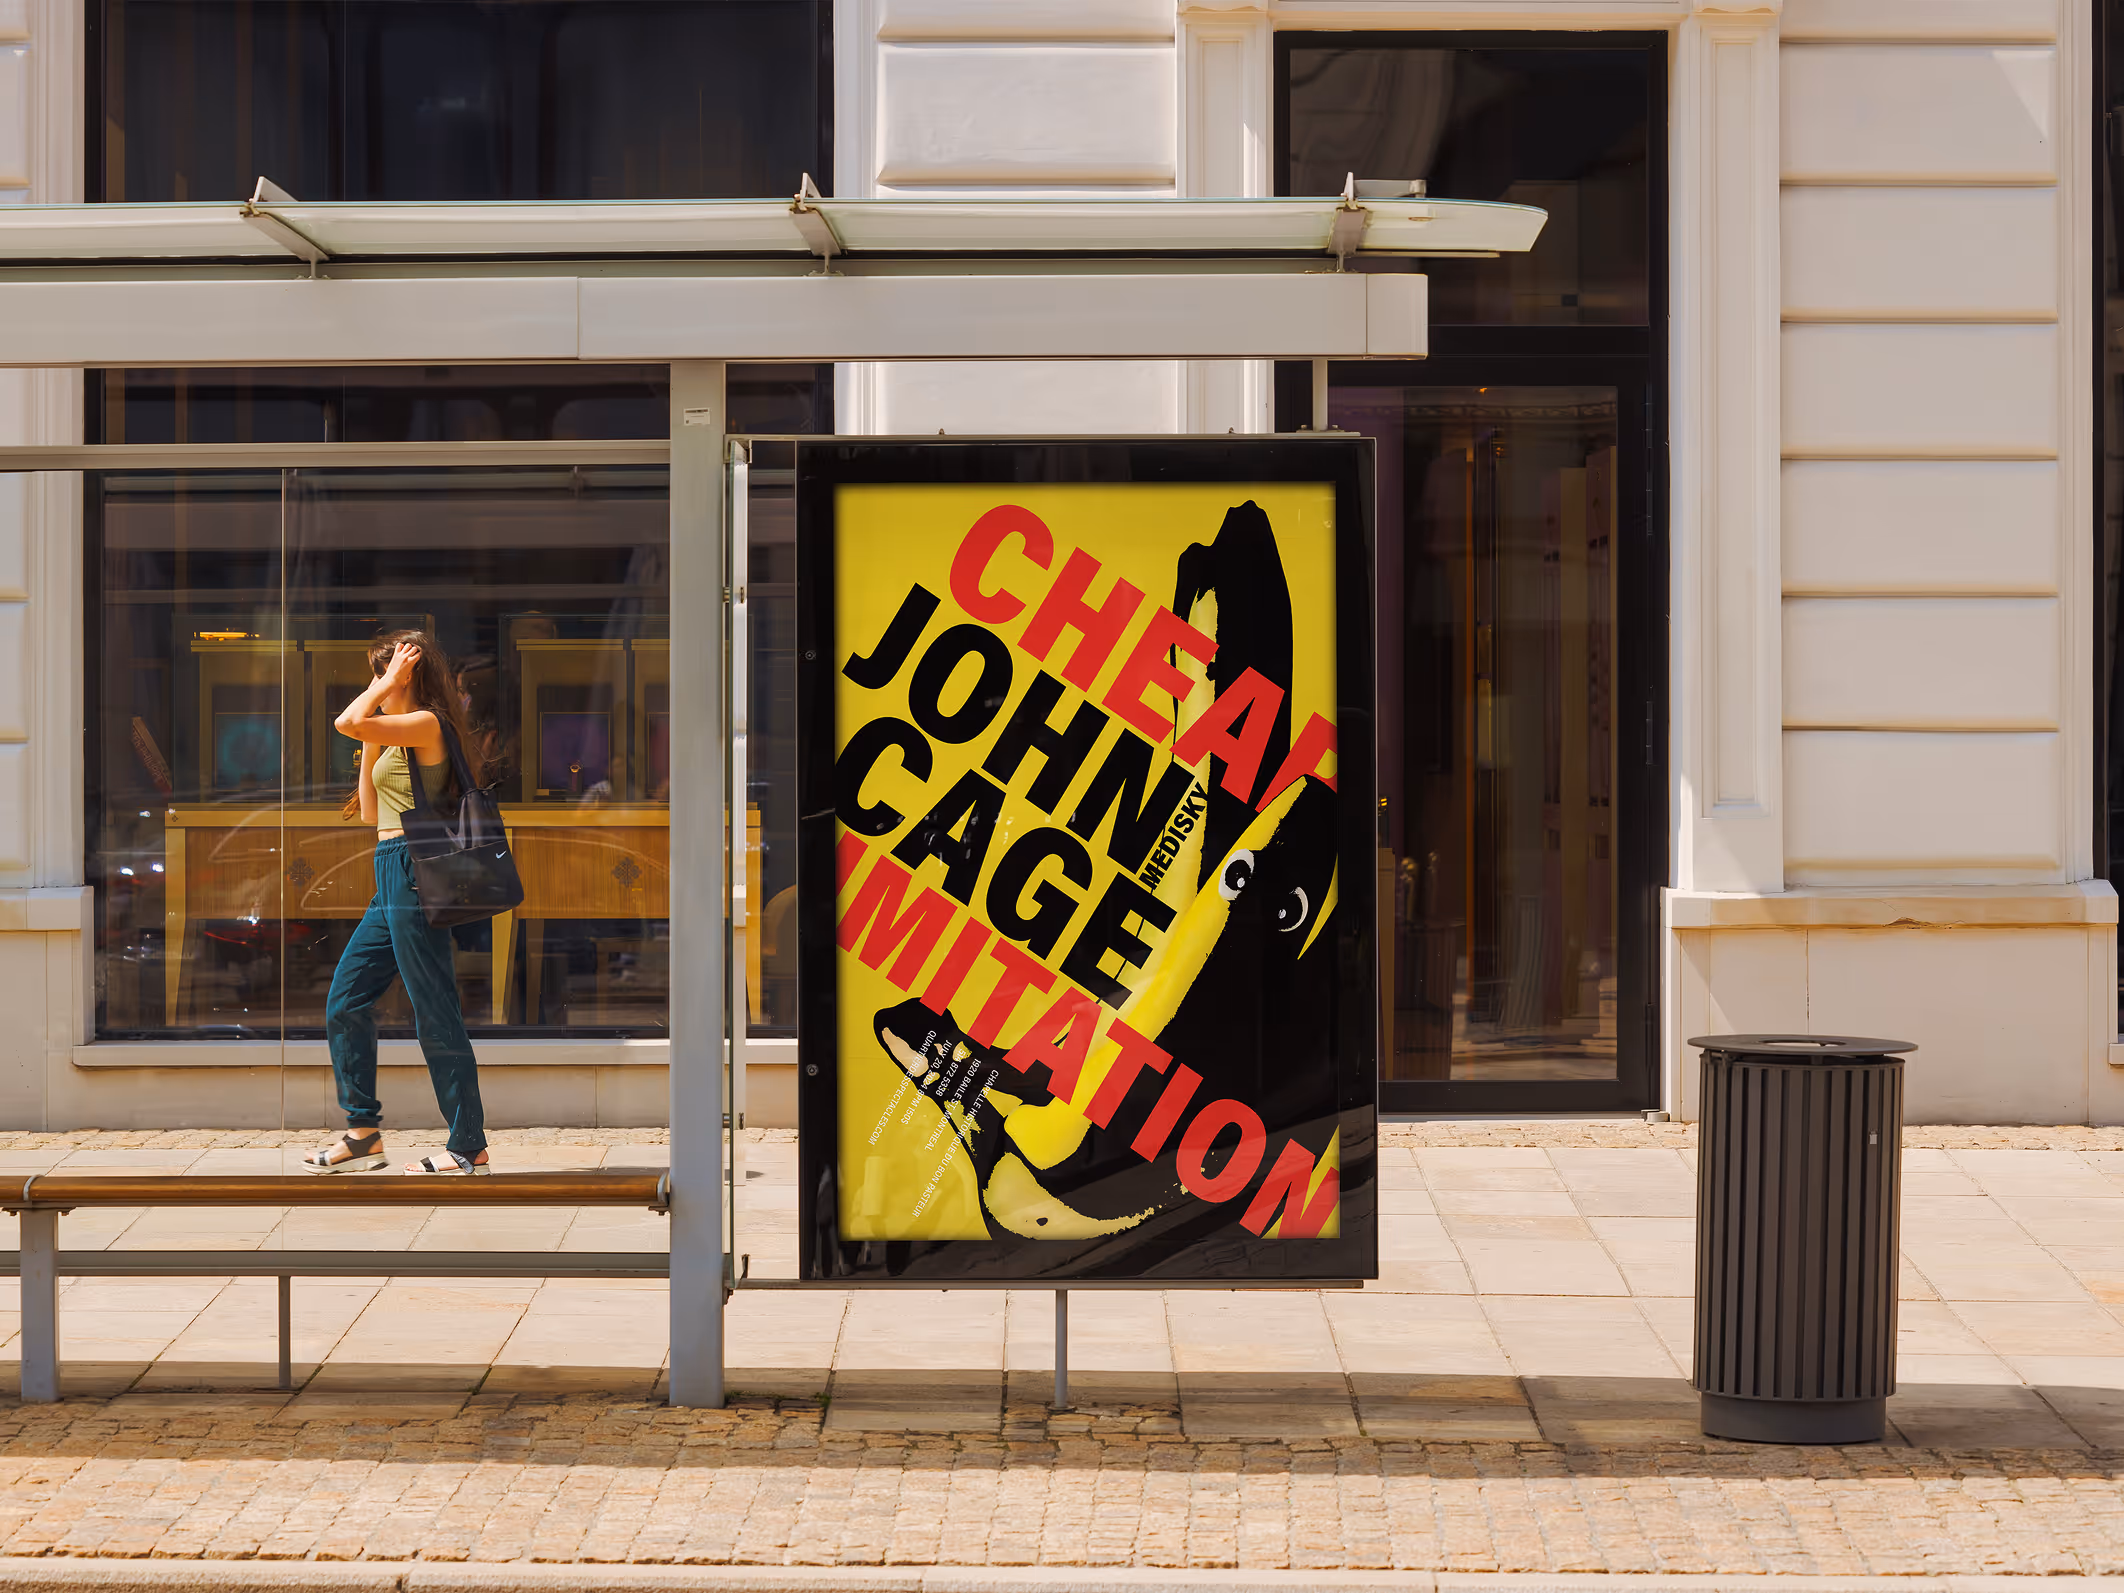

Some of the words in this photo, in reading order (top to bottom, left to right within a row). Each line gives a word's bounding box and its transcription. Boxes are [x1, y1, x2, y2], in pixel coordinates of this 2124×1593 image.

[842, 582, 1195, 875] JOHN
[1138, 781, 1208, 890] MEDISKY
[835, 717, 1177, 1011] CAGE
[938, 1039, 953, 1058] JULY
[954, 1048, 967, 1063] 514
[930, 1057, 943, 1070] 20,
[946, 1062, 959, 1078] 872
[967, 1058, 982, 1077] 1920
[868, 1029, 937, 1145] QUARTIERDESSPECTACLES.COM
[920, 1069, 936, 1089] 2024
[935, 1076, 951, 1097] 5338
[954, 1076, 971, 1100] BAILE
[973, 1069, 1000, 1109] CHAPELLE
[924, 1110, 952, 1152] MONTREAL
[947, 1107, 978, 1154] HISTORIQUE
[941, 1153, 953, 1166] DU
[931, 1165, 946, 1183] BON
[911, 1182, 936, 1218] PASTEUR
